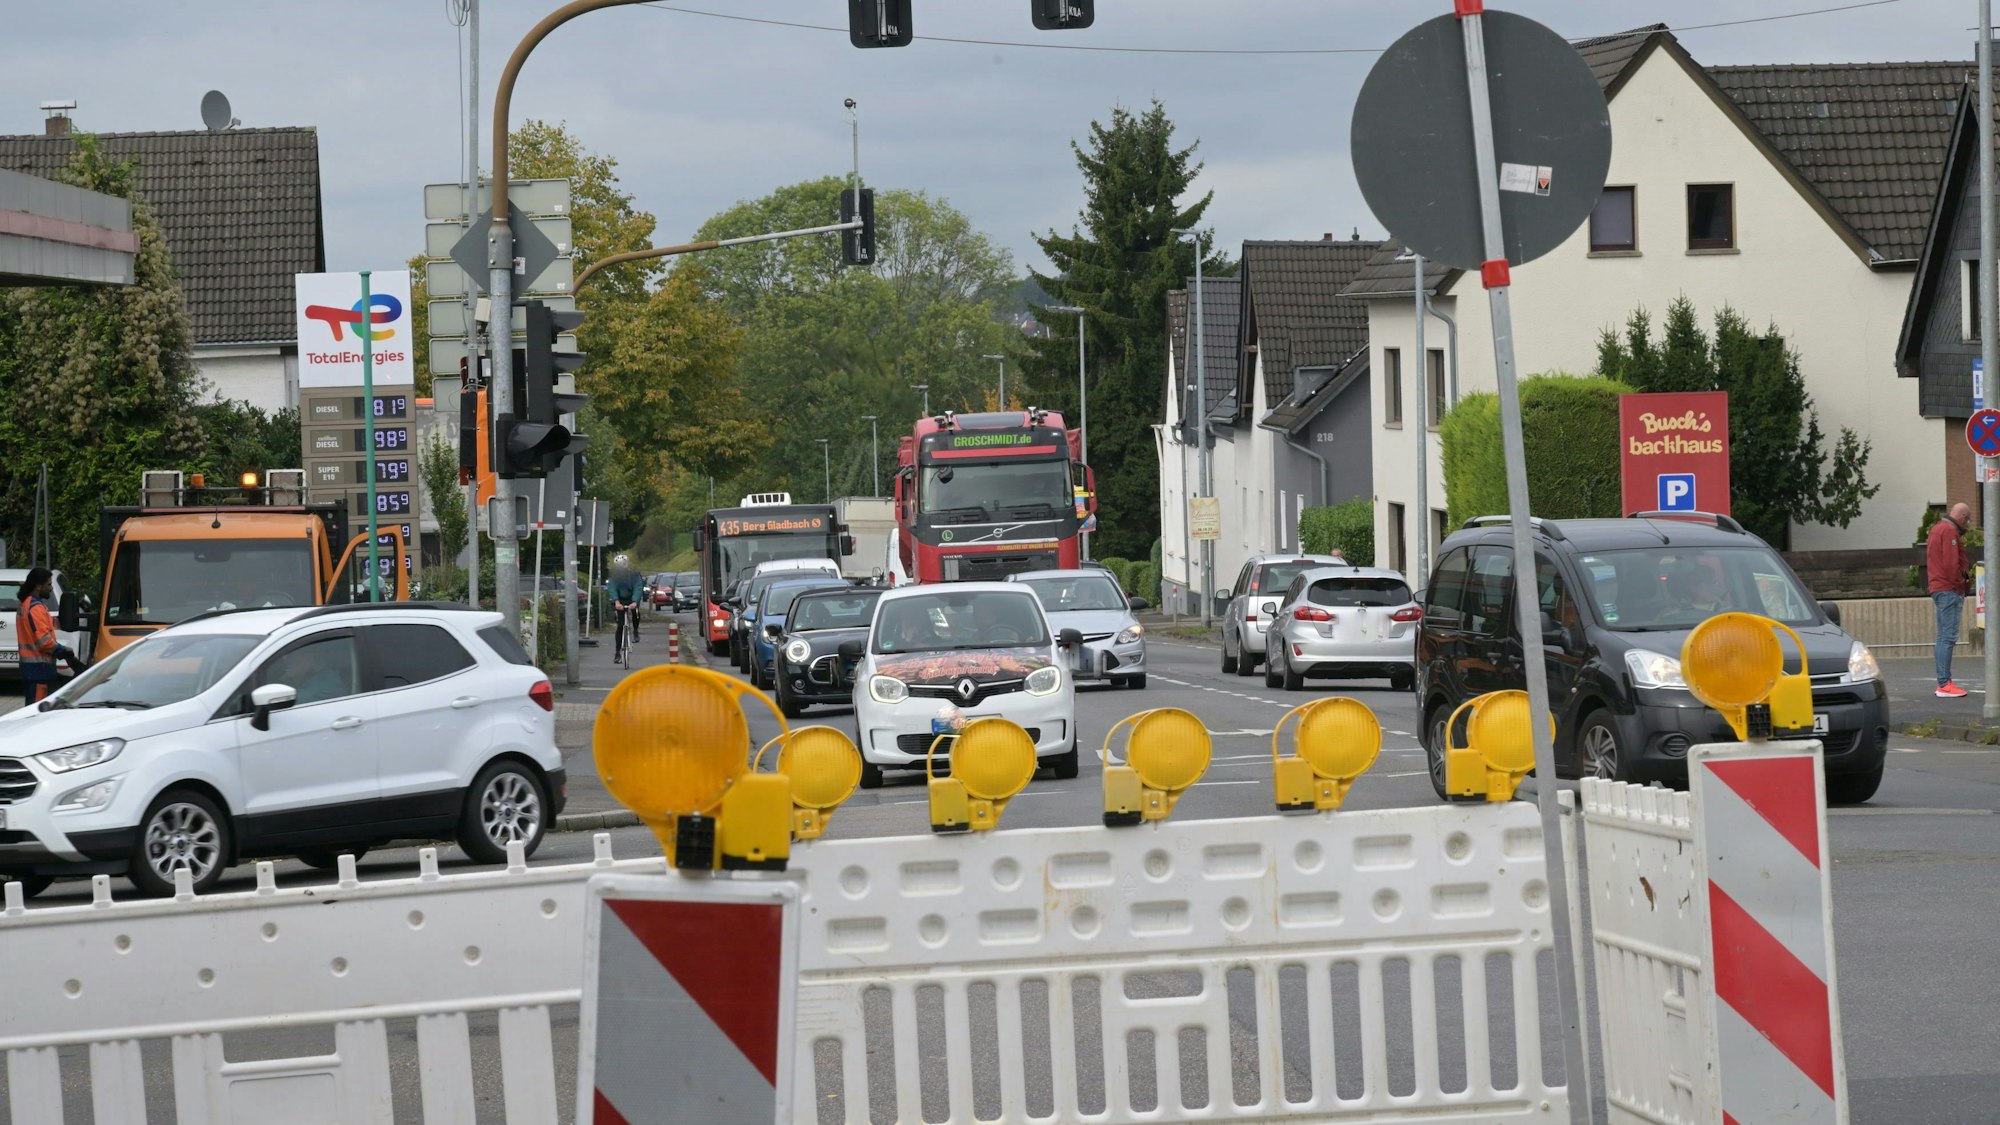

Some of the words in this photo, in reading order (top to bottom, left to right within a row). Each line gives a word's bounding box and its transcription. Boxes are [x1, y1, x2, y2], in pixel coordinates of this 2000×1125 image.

[306, 349, 405, 366] TotalEnrgies
[315, 405, 340, 414] DIESEL
[1639, 410, 1712, 434] Busch's
[315, 441, 340, 449] DIESEL
[953, 433, 1032, 448] GROSCHMIDT.de
[1316, 432, 1334, 442] 218
[1628, 434, 1724, 455] backhaus
[317, 466, 340, 474] SUPER
[1666, 480, 1690, 507] P
[719, 520, 741, 536] 435
[742, 521, 766, 532] Berg
[767, 518, 810, 530] Gladbach
